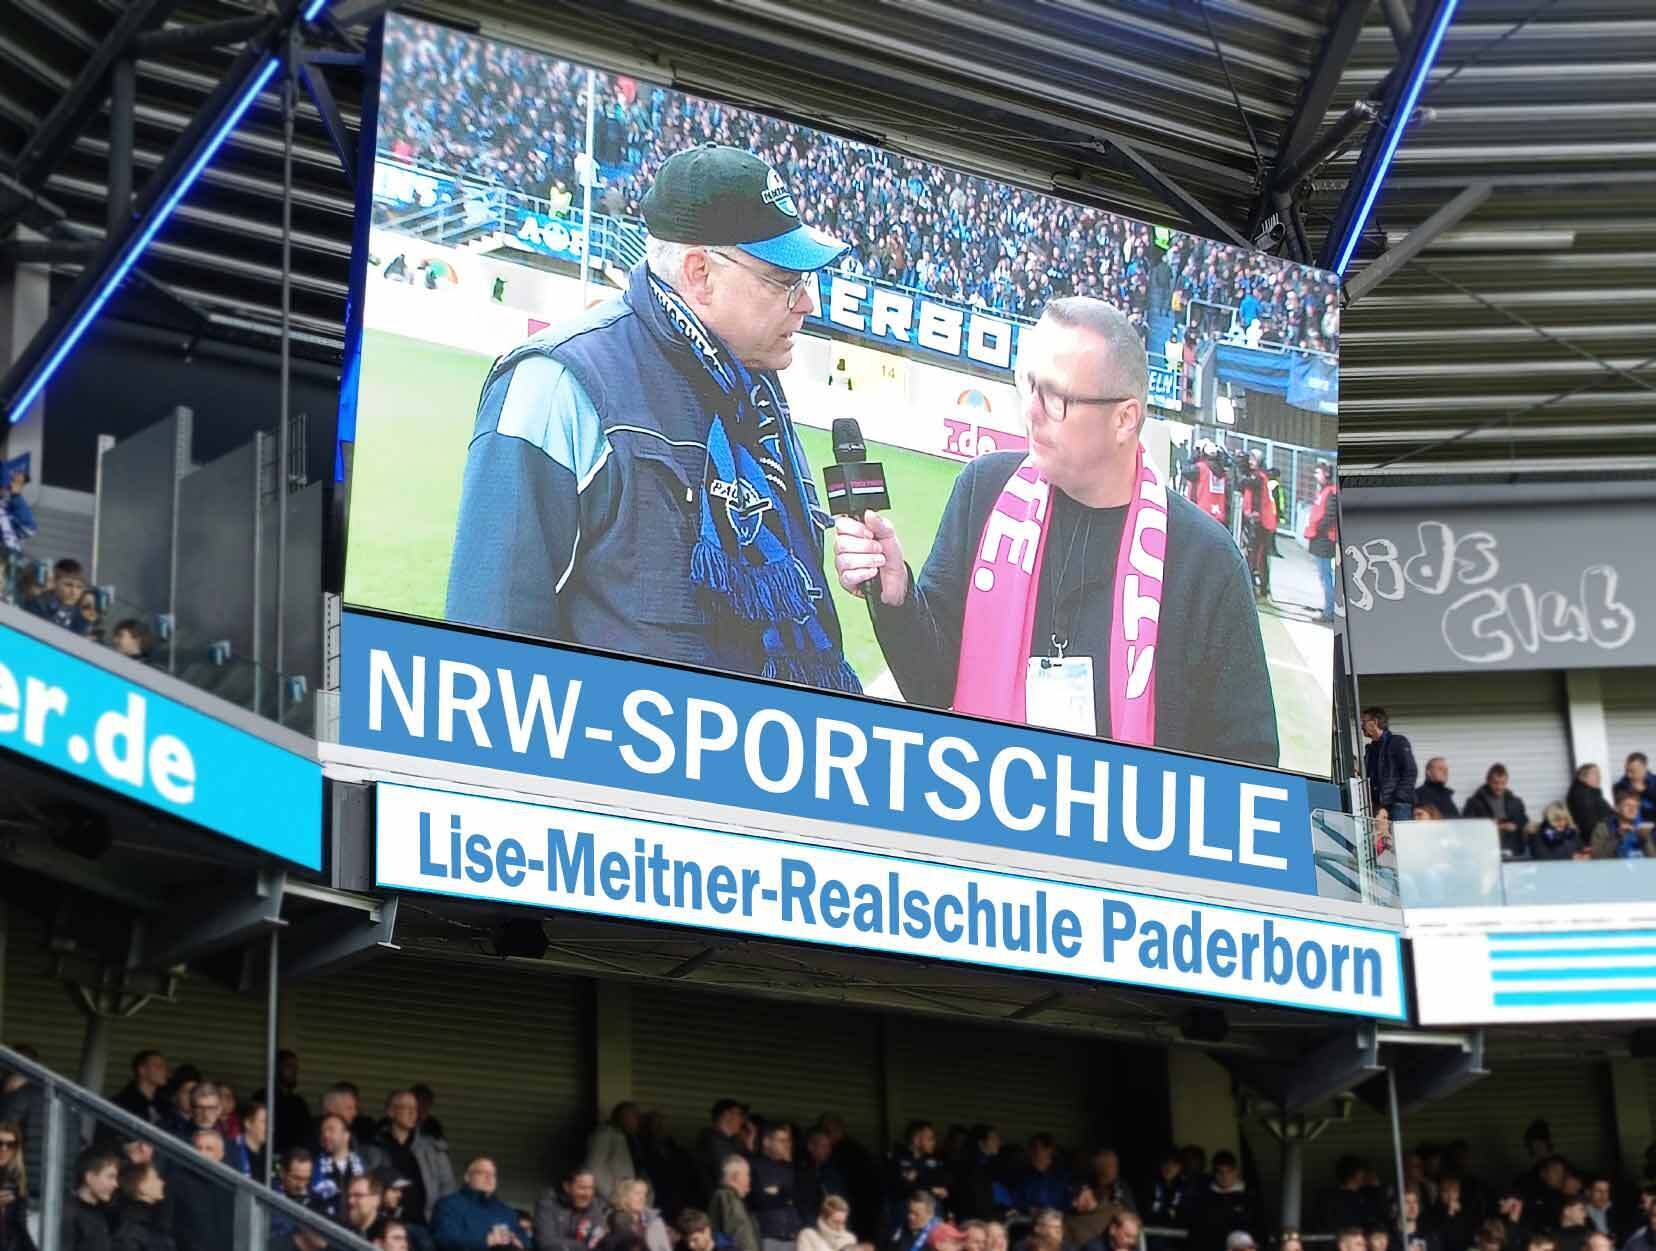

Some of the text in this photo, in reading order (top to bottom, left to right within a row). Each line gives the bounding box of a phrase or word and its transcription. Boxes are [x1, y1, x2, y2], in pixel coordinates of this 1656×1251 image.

[1441, 564, 1636, 664] Club
[367, 648, 1290, 871] NRW-SPORTSCHULE
[418, 810, 1383, 998] Lise-Meitner-Realschule Paderborn
